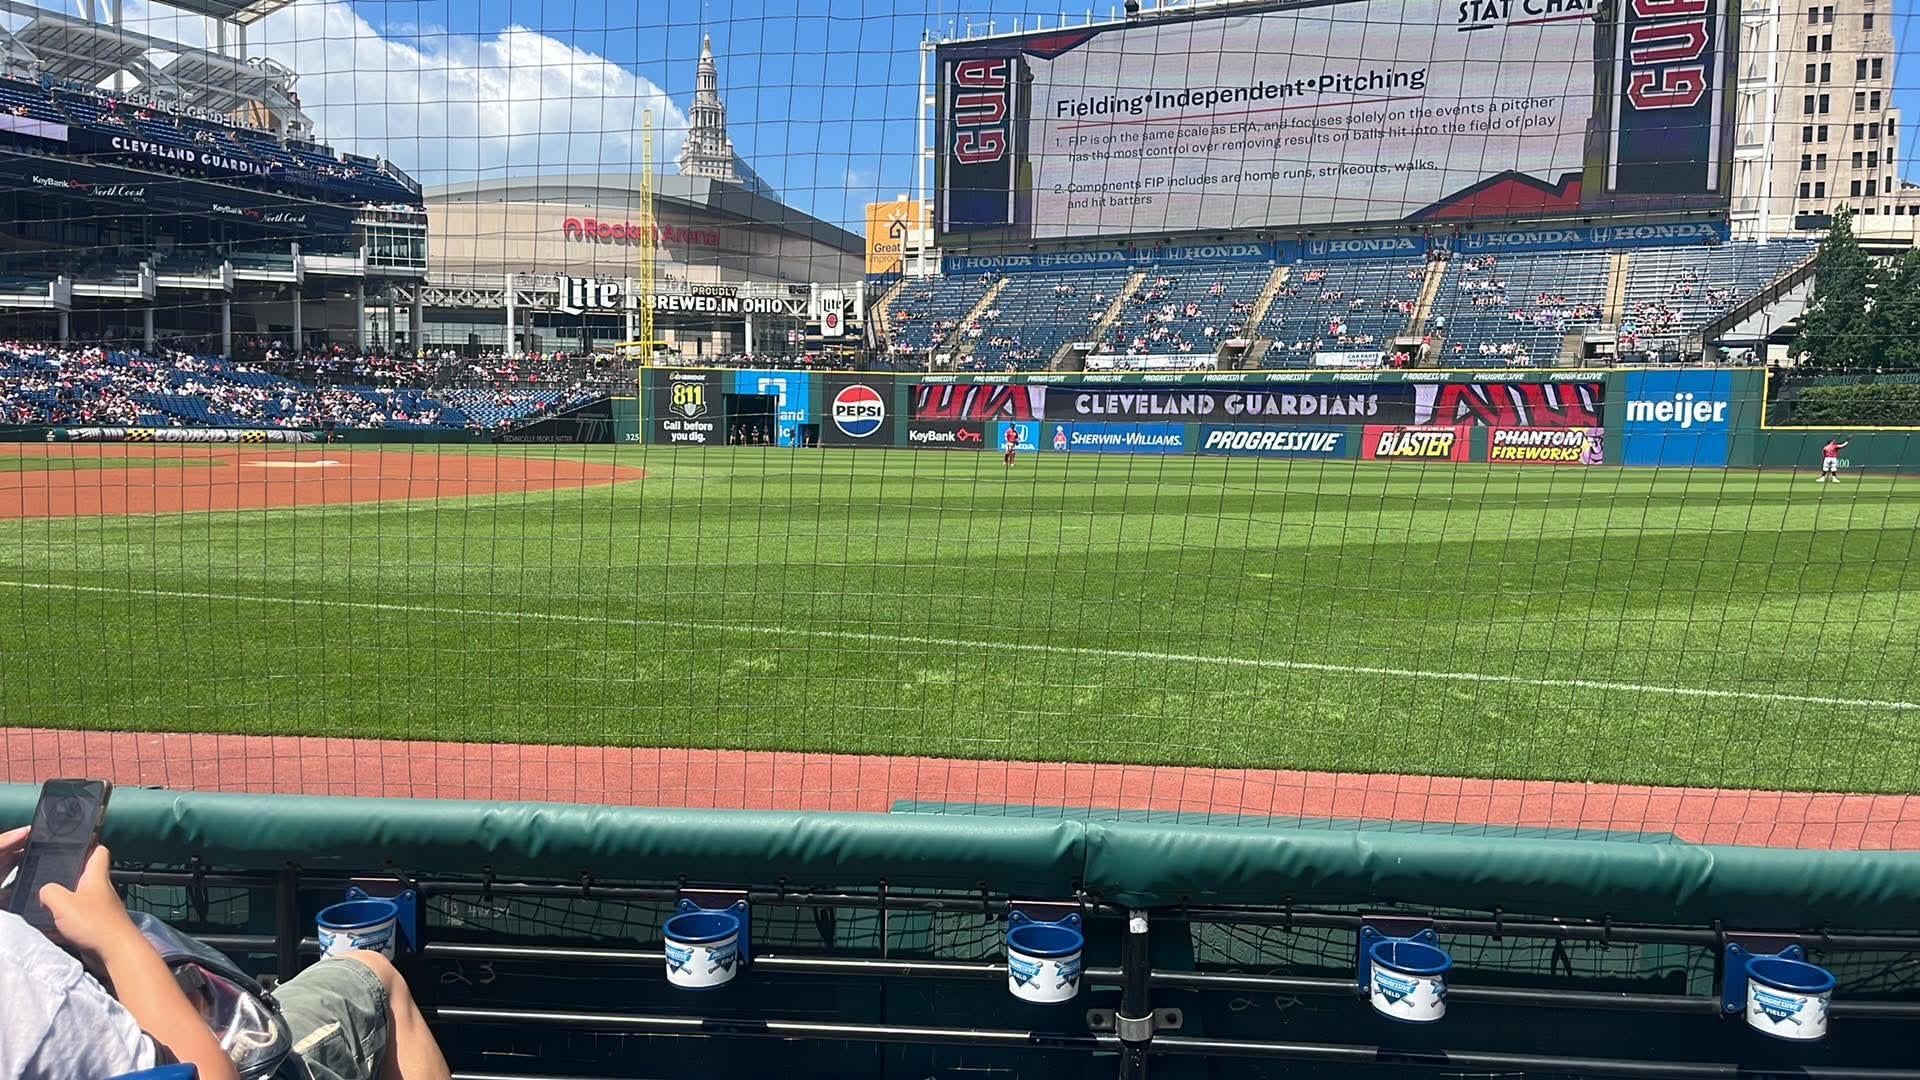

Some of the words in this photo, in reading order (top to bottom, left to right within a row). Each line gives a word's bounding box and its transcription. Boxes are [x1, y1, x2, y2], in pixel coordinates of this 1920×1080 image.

[1458, 1, 1514, 23] STAT
[1057, 96, 1143, 118] Fielding
[1155, 80, 1305, 109] Independent
[1318, 67, 1426, 94] Pitching
[954, 57, 1017, 167] GUA
[1069, 136, 1087, 147] FIP
[1090, 137, 1100, 145] is
[1102, 134, 1117, 144] on
[1120, 132, 1139, 143] the
[1142, 129, 1174, 142] same
[1177, 124, 1208, 138] scale
[1212, 126, 1226, 135] as
[1264, 119, 1288, 130] and
[1291, 116, 1342, 128] focuses
[1346, 112, 1384, 125] solely
[1388, 111, 1405, 121] on
[1409, 107, 1431, 119] the
[1436, 103, 1484, 116] events
[1489, 104, 1497, 113] a
[1501, 97, 1556, 114] pitcher
[1068, 151, 1089, 163] has
[1092, 148, 1110, 160] the
[1113, 145, 1143, 158] most
[1146, 141, 1190, 156] control
[1192, 141, 1220, 152] over
[1222, 136, 1281, 151] removing
[1285, 132, 1329, 146] results
[1333, 130, 1349, 141] on
[1353, 126, 1385, 140] balls
[1389, 125, 1407, 137] hit
[1411, 122, 1438, 136] into
[1442, 119, 1465, 133] the
[1470, 116, 1500, 131] field
[1505, 114, 1521, 128] of
[1524, 113, 1556, 130] play
[112, 137, 195, 162] CLEVELAND
[33, 176, 69, 188] KeyBank
[1067, 178, 1141, 195] Components
[1144, 177, 1164, 188] FIP
[1168, 173, 1218, 187] includes
[1222, 173, 1242, 184] are
[1244, 169, 1280, 182] home
[1283, 168, 1317, 180] runs,
[1319, 161, 1391, 177] strikeouts,
[1394, 158, 1439, 172] walks,
[1068, 197, 1088, 209] and
[1091, 196, 1106, 207] hit
[1110, 194, 1152, 206] batters
[1487, 230, 1581, 246] HONDA
[1614, 224, 1716, 240] HONDA
[874, 243, 900, 252] Great
[1184, 245, 1263, 258] HONDA
[1329, 238, 1415, 251] HONDA
[967, 256, 1034, 268] HONDA
[1055, 252, 1127, 267] HONDA
[556, 275, 620, 316] Lite
[692, 286, 738, 297] PROUDLY
[721, 298, 740, 313] IN
[743, 298, 784, 314] OHIO
[1266, 374, 1312, 382] PROGRESSIVE
[1549, 372, 1603, 380] PROGRESSIVE
[673, 384, 702, 406] 811
[836, 405, 882, 417] PEPSI
[1075, 394, 1215, 415] CLEVELAND
[1224, 394, 1379, 416] GUARDIANS
[1627, 392, 1728, 429] meijer
[664, 421, 681, 431] Call
[684, 421, 713, 431] before
[626, 433, 641, 442] 325
[671, 433, 688, 443] you
[909, 431, 956, 444] KeyBank
[1205, 431, 1341, 452] PROGRESSIVE
[1376, 431, 1455, 457] BLASTER
[1494, 431, 1583, 447] PHANTOM
[1490, 446, 1580, 462] FIREWORKS
[1766, 1007, 1787, 1018] FIELD
